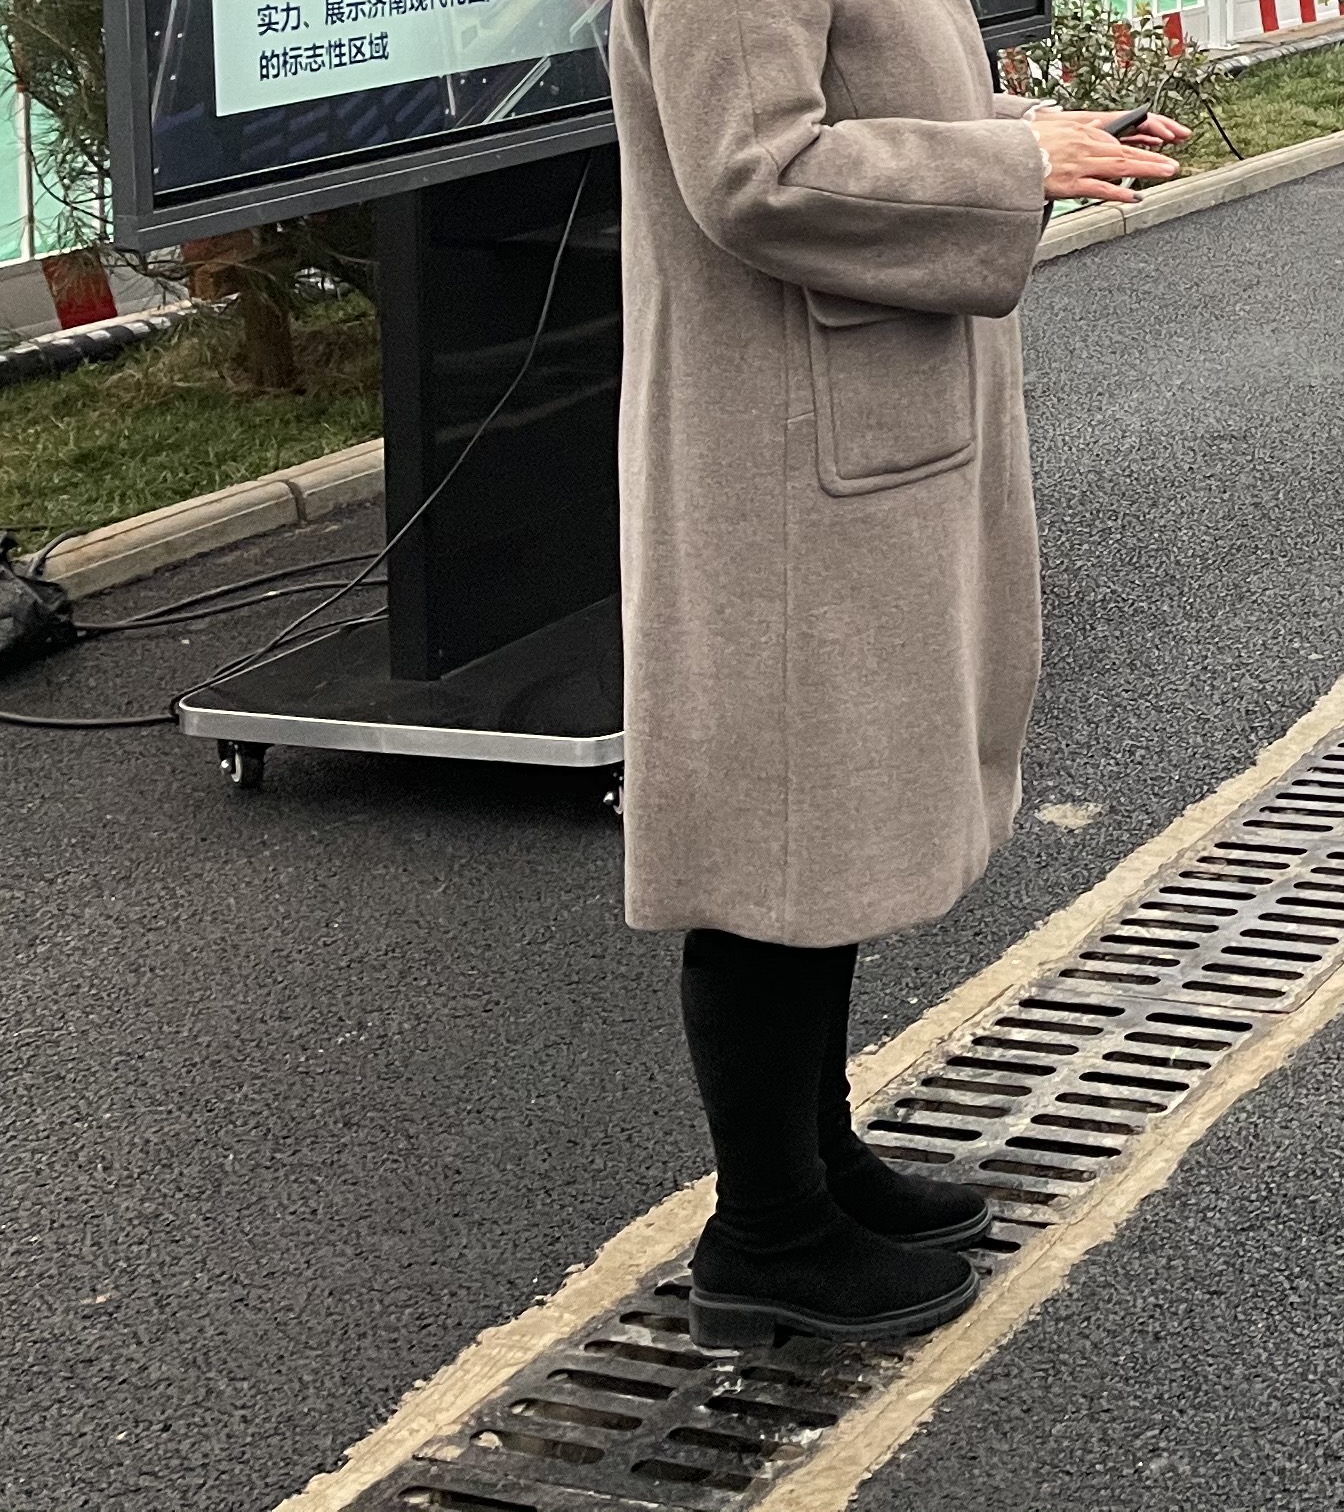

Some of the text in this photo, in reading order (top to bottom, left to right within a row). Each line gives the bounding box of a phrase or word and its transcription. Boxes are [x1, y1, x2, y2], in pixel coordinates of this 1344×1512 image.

[258, 32, 390, 81] 的标志性区域
